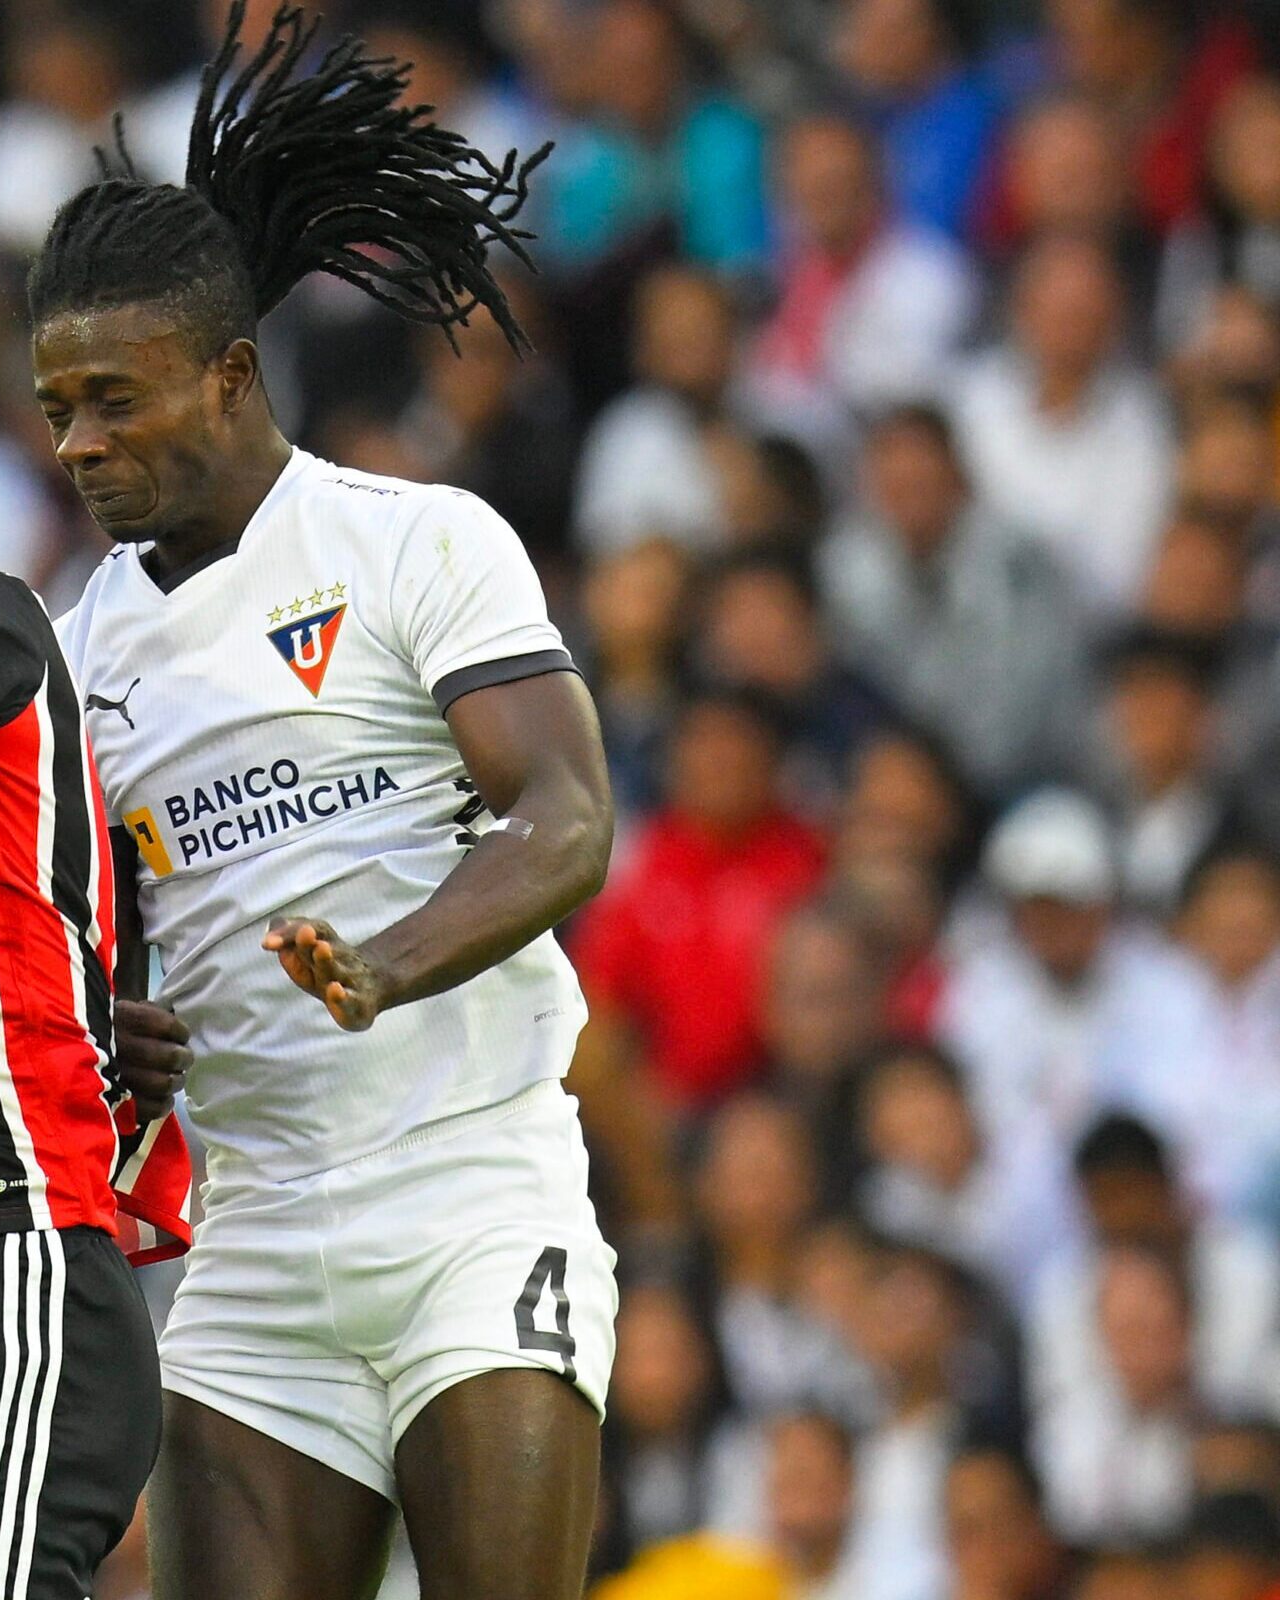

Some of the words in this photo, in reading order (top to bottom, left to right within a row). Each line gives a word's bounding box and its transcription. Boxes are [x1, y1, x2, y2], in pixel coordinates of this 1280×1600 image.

[164, 758, 300, 829] BANCO
[177, 766, 401, 867] PICHINCHA
[513, 1245, 577, 1383] 4
